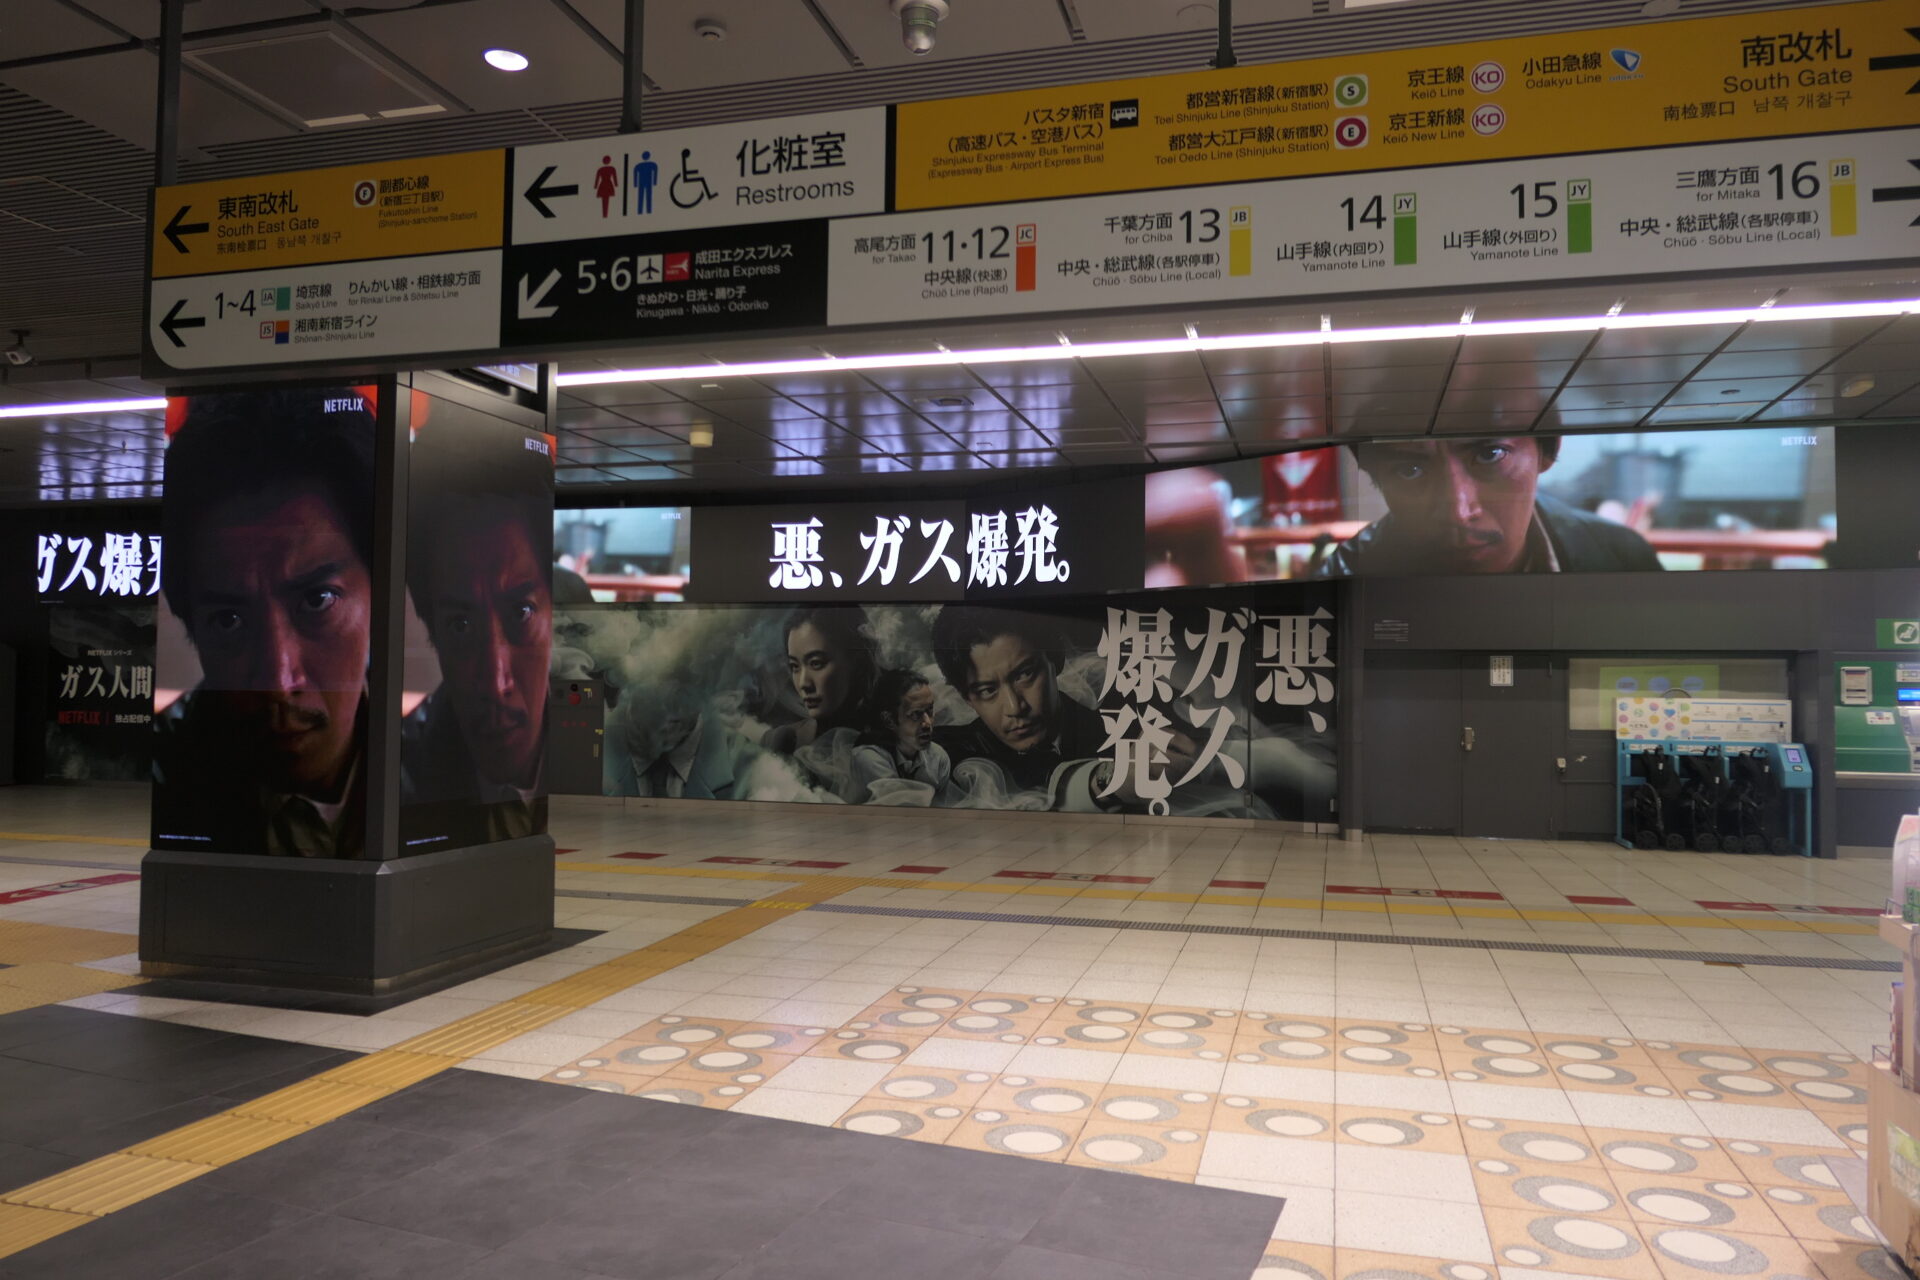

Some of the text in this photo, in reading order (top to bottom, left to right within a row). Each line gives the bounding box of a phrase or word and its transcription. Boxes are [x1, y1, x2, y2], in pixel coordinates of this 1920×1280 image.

[1740, 28, 1852, 68] 南改札
[1522, 51, 1603, 76] 小田急線
[1407, 65, 1465, 88] 京王線
[1474, 70, 1500, 85] KO
[1526, 77, 1573, 90] Odakyu
[1576, 73, 1602, 84] Line
[1723, 68, 1852, 94] South Gate
[1347, 86, 1355, 96] S
[1440, 87, 1465, 97] Line
[1663, 100, 1735, 121] 南检票口
[1753, 90, 1852, 113] 남쪽 개찰구
[1024, 102, 1104, 125] バスタ新宿
[1154, 100, 1330, 125] Toei Shinjuku Line (Shinjuku Station)
[1389, 107, 1465, 131] 京王新線
[1475, 112, 1501, 127] KO
[1347, 127, 1355, 137] E
[1411, 131, 1437, 142] New
[1440, 129, 1465, 140] Line
[736, 131, 846, 177] 化粧室
[932, 142, 1104, 167] Shinjuku Expressway Bus Terminal
[1154, 140, 1330, 165] Toei Oedo Line (Shinjuku Station)
[928, 167, 983, 180] (Expressway
[986, 164, 1003, 173] Bus
[1010, 160, 1042, 171] Airport
[1044, 157, 1081, 168] Express
[1083, 154, 1104, 164] Bus)
[1833, 164, 1850, 177] JB
[380, 175, 429, 193] 副都心線
[1676, 165, 1760, 189] 三鷹方面
[1767, 160, 1820, 201] 16
[362, 189, 368, 198] F
[736, 181, 855, 206] Restrooms
[1571, 185, 1587, 196] JY
[1696, 188, 1760, 202] for Mitaka
[217, 189, 298, 220] 東南改札
[1397, 199, 1412, 210] JY
[1510, 181, 1558, 219] 15
[379, 206, 438, 218] Fukutoshin Line
[1232, 211, 1247, 223] JB
[1340, 195, 1387, 231] 14
[217, 217, 320, 238] South East Gate
[1104, 212, 1173, 234] 千葉方面
[1179, 207, 1221, 243] 13
[1019, 228, 1033, 239] JC
[1125, 233, 1173, 244] for Chiba
[1746, 230, 1773, 242] Line
[1777, 228, 1821, 242] (Local)
[854, 233, 916, 254] 高尾方面
[695, 244, 793, 265] 成田エクスプレス
[872, 253, 916, 264] for Takao
[1470, 246, 1558, 261] Yamanote Line
[695, 266, 730, 280] Narita
[733, 263, 781, 278] Express
[1302, 257, 1386, 273] Yamanote Line
[1160, 272, 1183, 282] Line
[1185, 269, 1221, 282] (Local)
[263, 294, 273, 302] JA
[296, 283, 332, 298] 埼京線
[348, 297, 358, 306] for
[360, 295, 384, 305] Rinkai
[386, 293, 400, 303] Line
[403, 293, 409, 301] &
[442, 289, 459, 299] Line
[950, 286, 970, 297] Line
[973, 284, 1009, 297] (Rapid)
[322, 299, 338, 308] Line
[636, 306, 684, 319] Kinugawa
[728, 299, 769, 312] Odoriko
[263, 325, 272, 334] JS
[295, 314, 378, 333] 湘南新宿ライン
[359, 330, 375, 339] Line
[324, 397, 363, 414] NETFLIX
[525, 437, 549, 456] NETFLIX
[1781, 435, 1817, 447] NETFLIX
[768, 504, 1070, 590] 悪、ガス爆発。
[1255, 606, 1336, 733] 悪、
[59, 664, 152, 700] ガス人間
[1173, 606, 1257, 789] ガス
[57, 710, 101, 726] NETFLIX
[1096, 606, 1177, 816] 爆発。
